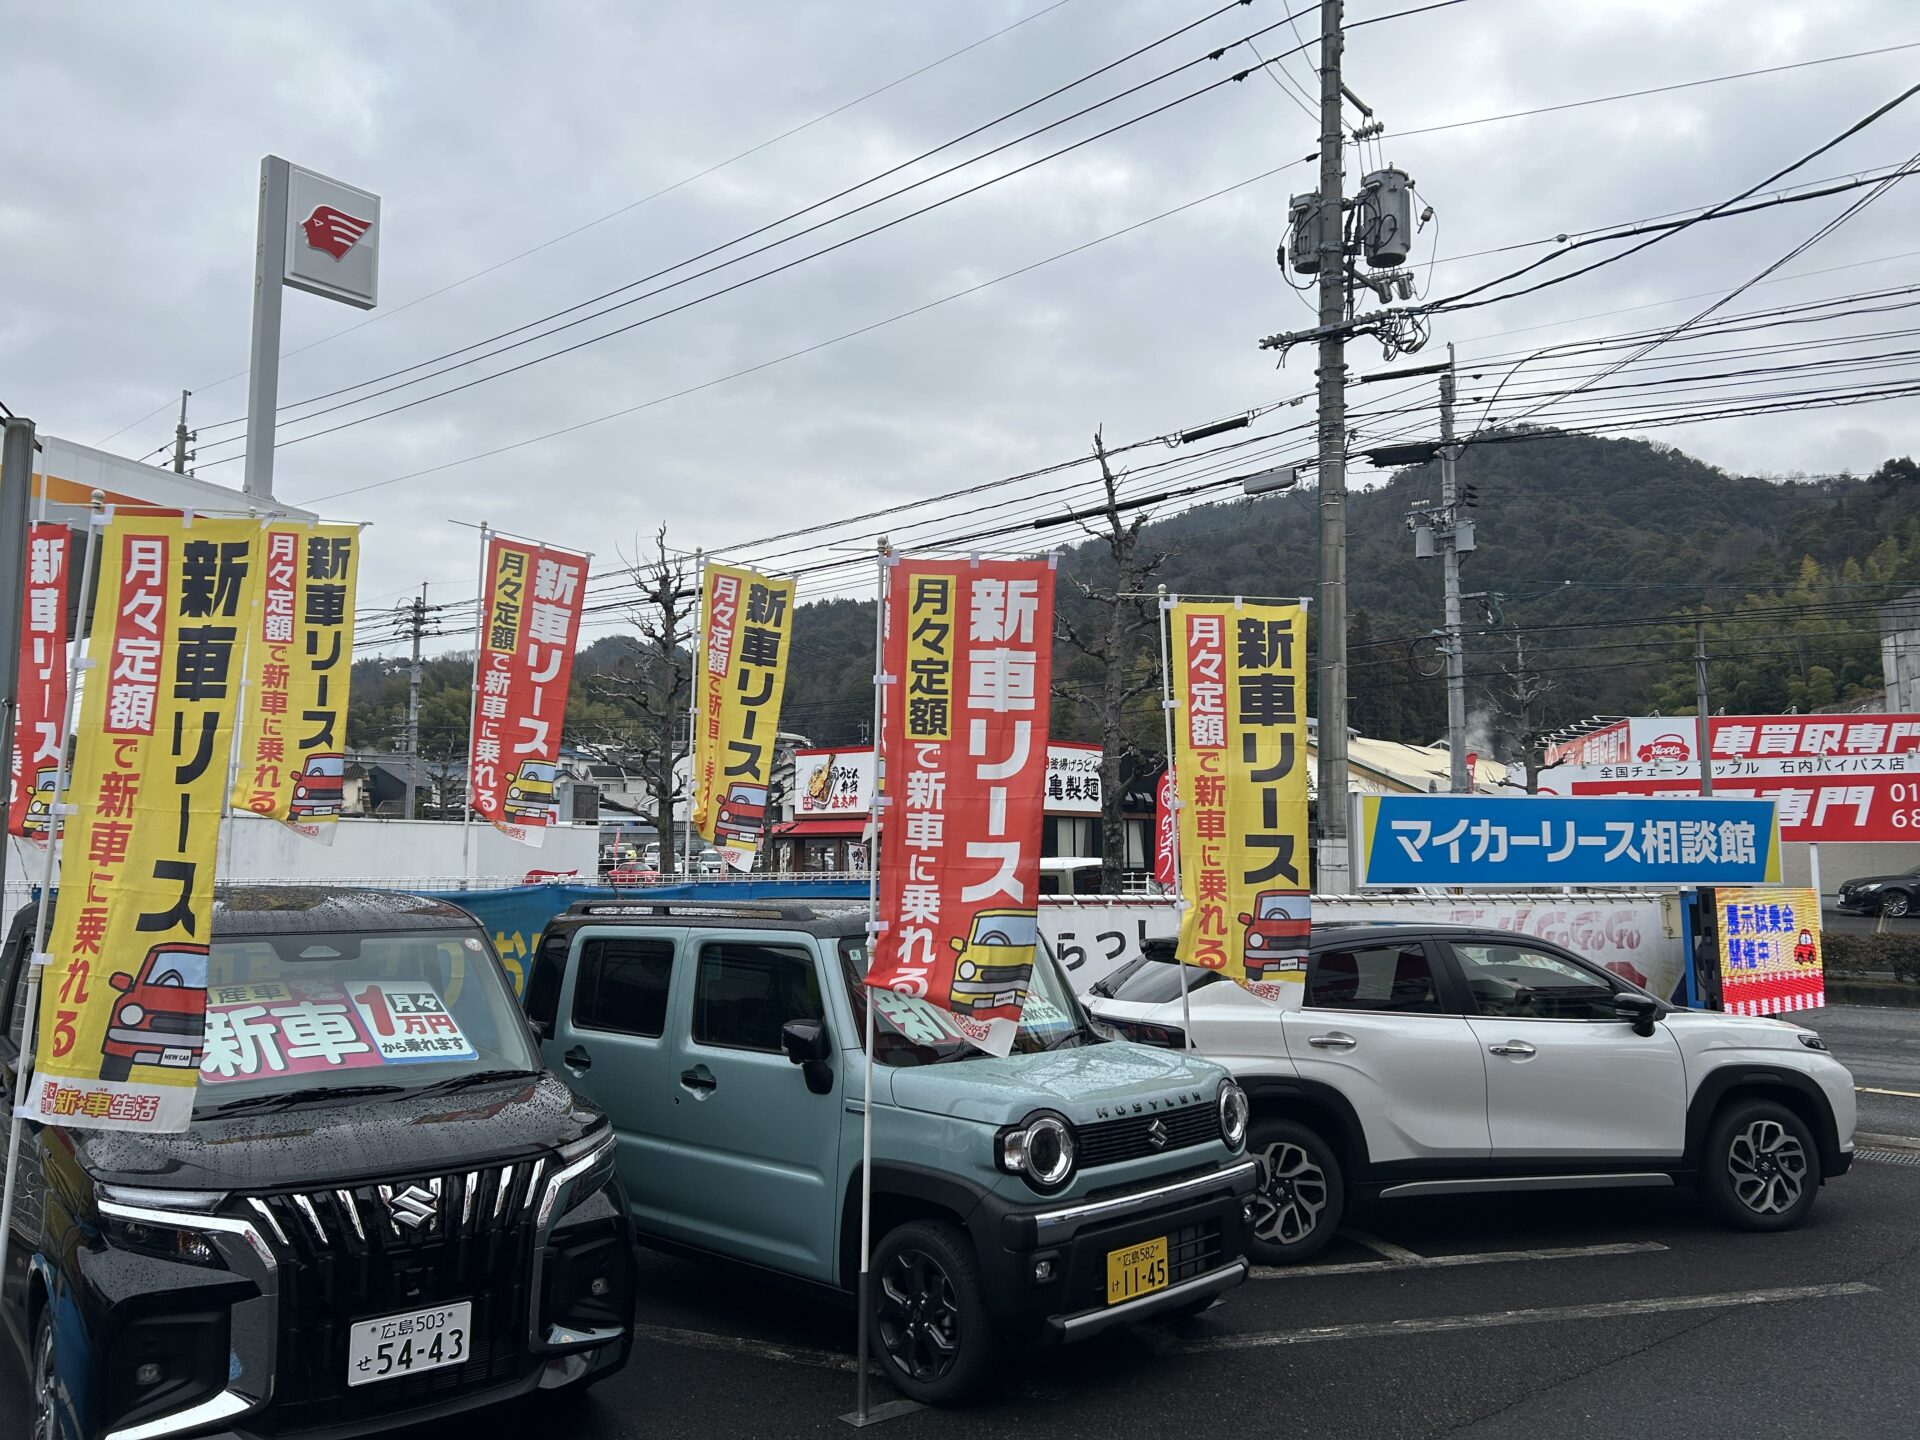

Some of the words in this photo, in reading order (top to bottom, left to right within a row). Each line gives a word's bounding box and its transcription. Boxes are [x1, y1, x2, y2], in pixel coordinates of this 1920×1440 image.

[298, 537, 351, 749] 新車リース
[514, 559, 579, 757] 新車リース
[725, 584, 787, 781] 新車リース
[136, 540, 249, 938] 新車リース
[961, 578, 1038, 904] 新車リース
[1237, 618, 1299, 886] 新車リース
[840, 766, 860, 780] うどん
[1600, 766, 1688, 779] 全国チェーン
[1699, 762, 1760, 776] ップル
[1780, 757, 1905, 774] 石内バイパス店
[840, 780, 858, 793] 弁当
[1045, 774, 1099, 801] 亀製麺
[1890, 783, 1919, 802] 01
[1892, 808, 1920, 828] 68
[1391, 819, 1756, 864] マイカーリース相談館
[206, 983, 285, 1004] 産車
[395, 994, 438, 1012] 月々
[396, 1014, 458, 1035] 万円
[200, 1001, 370, 1077] 新車
[382, 1037, 464, 1054] から乗れます
[163, 1054, 176, 1062] NEW
[178, 1055, 190, 1063] CAR
[1097, 1091, 1202, 1118] HUSTLER
[1125, 1258, 1165, 1296] 11-45
[381, 1319, 414, 1339] 広島
[416, 1312, 445, 1332] 503
[356, 1356, 373, 1371] せ
[377, 1329, 463, 1374] 54-43
